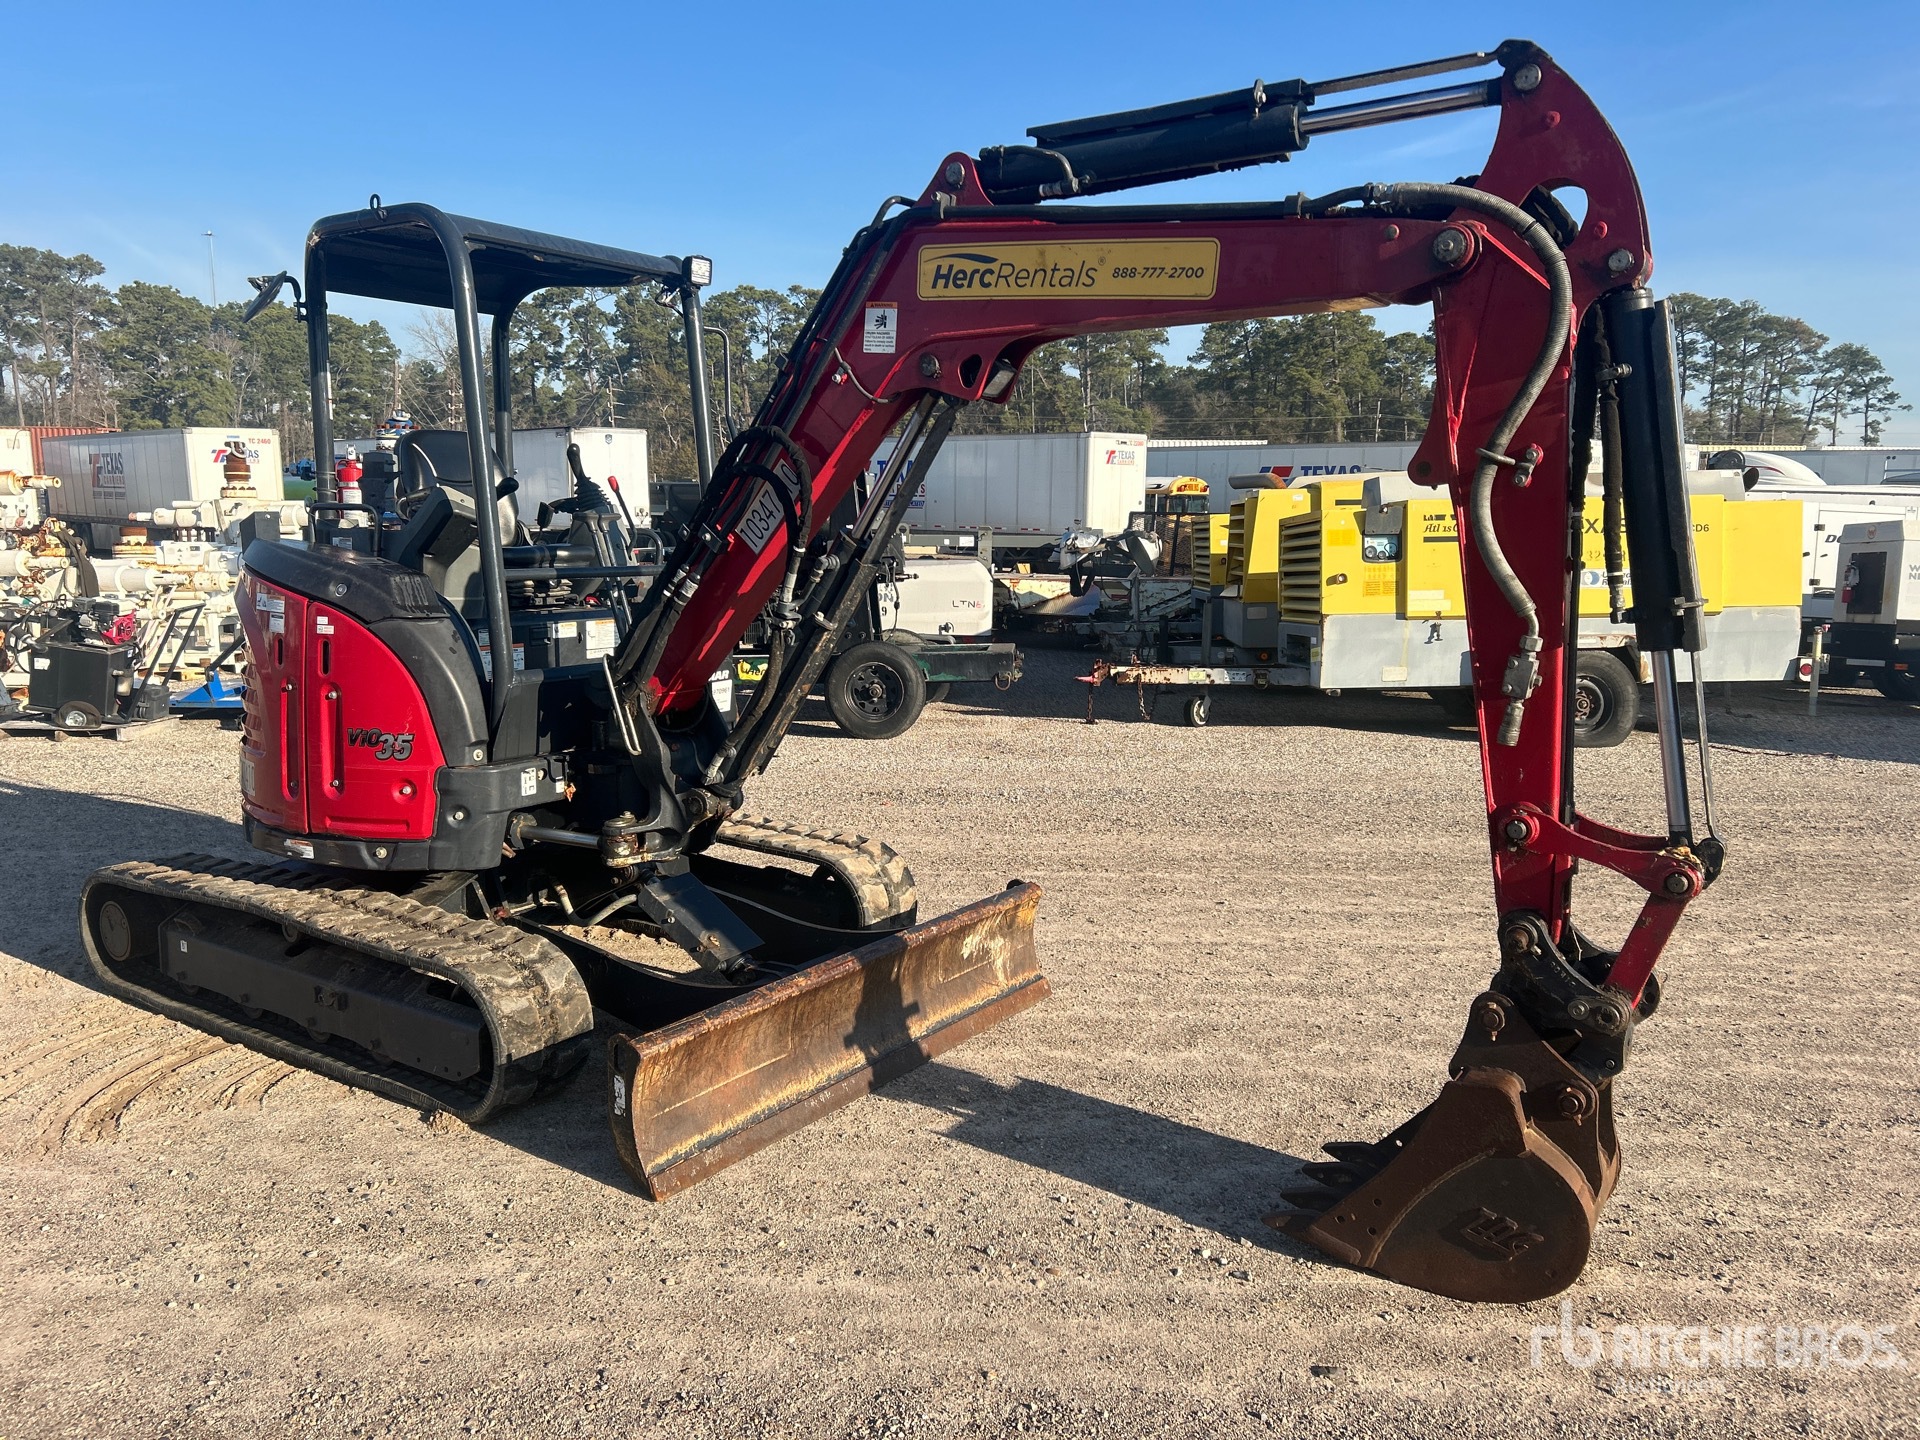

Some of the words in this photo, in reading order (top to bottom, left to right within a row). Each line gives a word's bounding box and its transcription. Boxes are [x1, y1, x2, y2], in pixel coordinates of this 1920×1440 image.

[930, 259, 1098, 289] HercRentals
[1112, 266, 1205, 279] 888-777-2700
[101, 452, 124, 475] TEXAS
[1118, 451, 1135, 460] TEXAS
